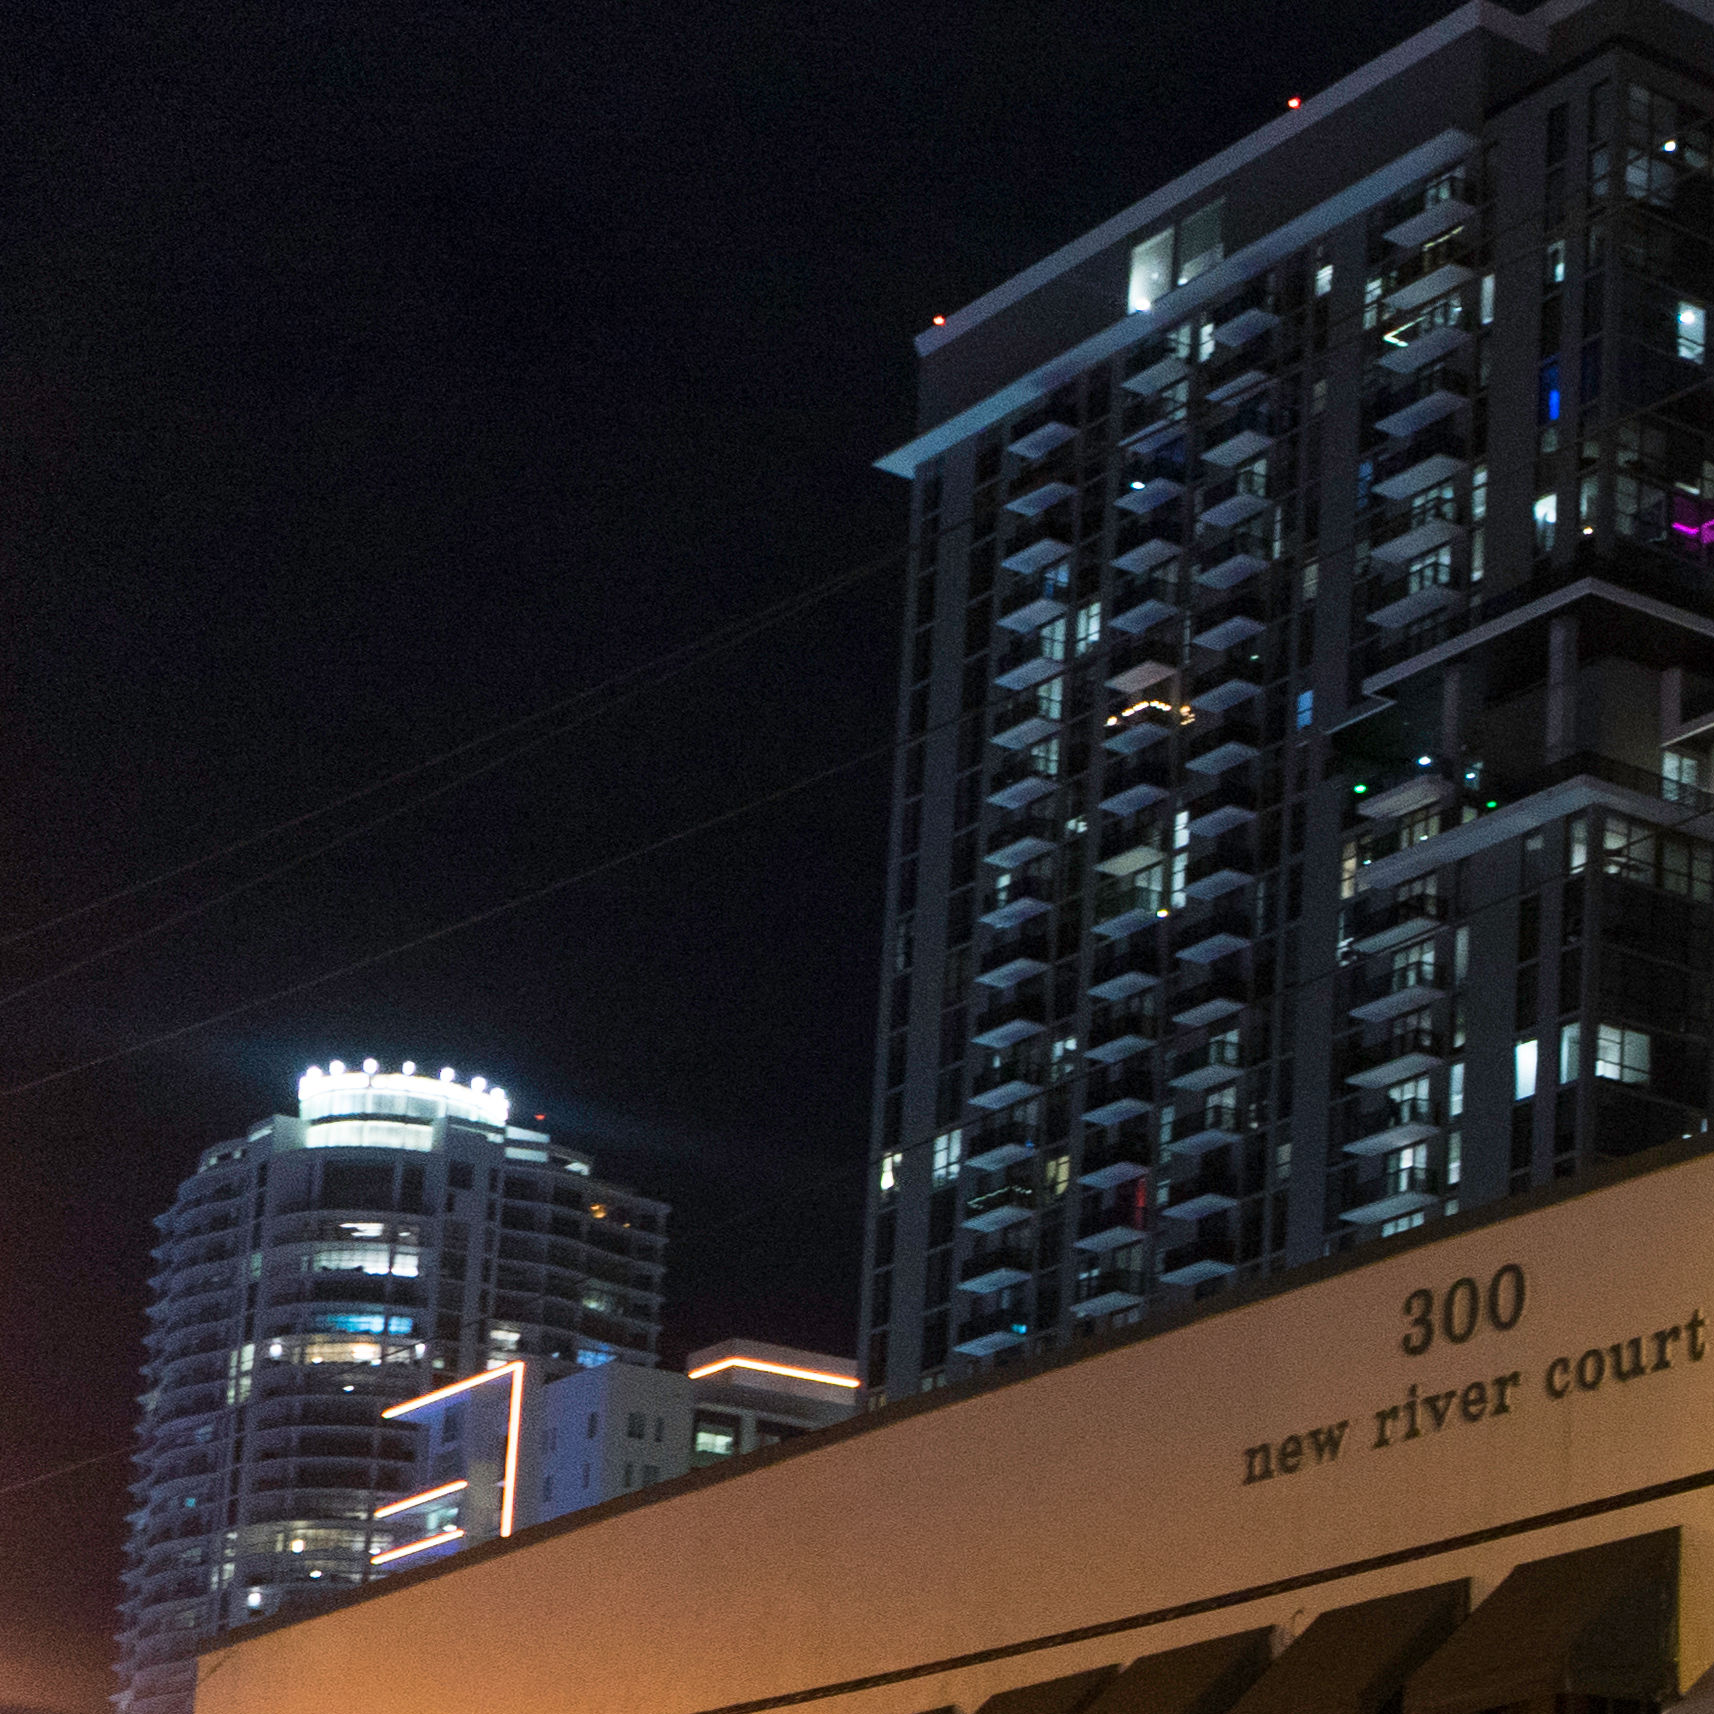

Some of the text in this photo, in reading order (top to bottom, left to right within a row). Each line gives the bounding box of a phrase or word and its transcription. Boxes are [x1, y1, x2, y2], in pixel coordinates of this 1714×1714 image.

[1401, 1263, 1527, 1357] 300
[1242, 1308, 1707, 1486] new river court
